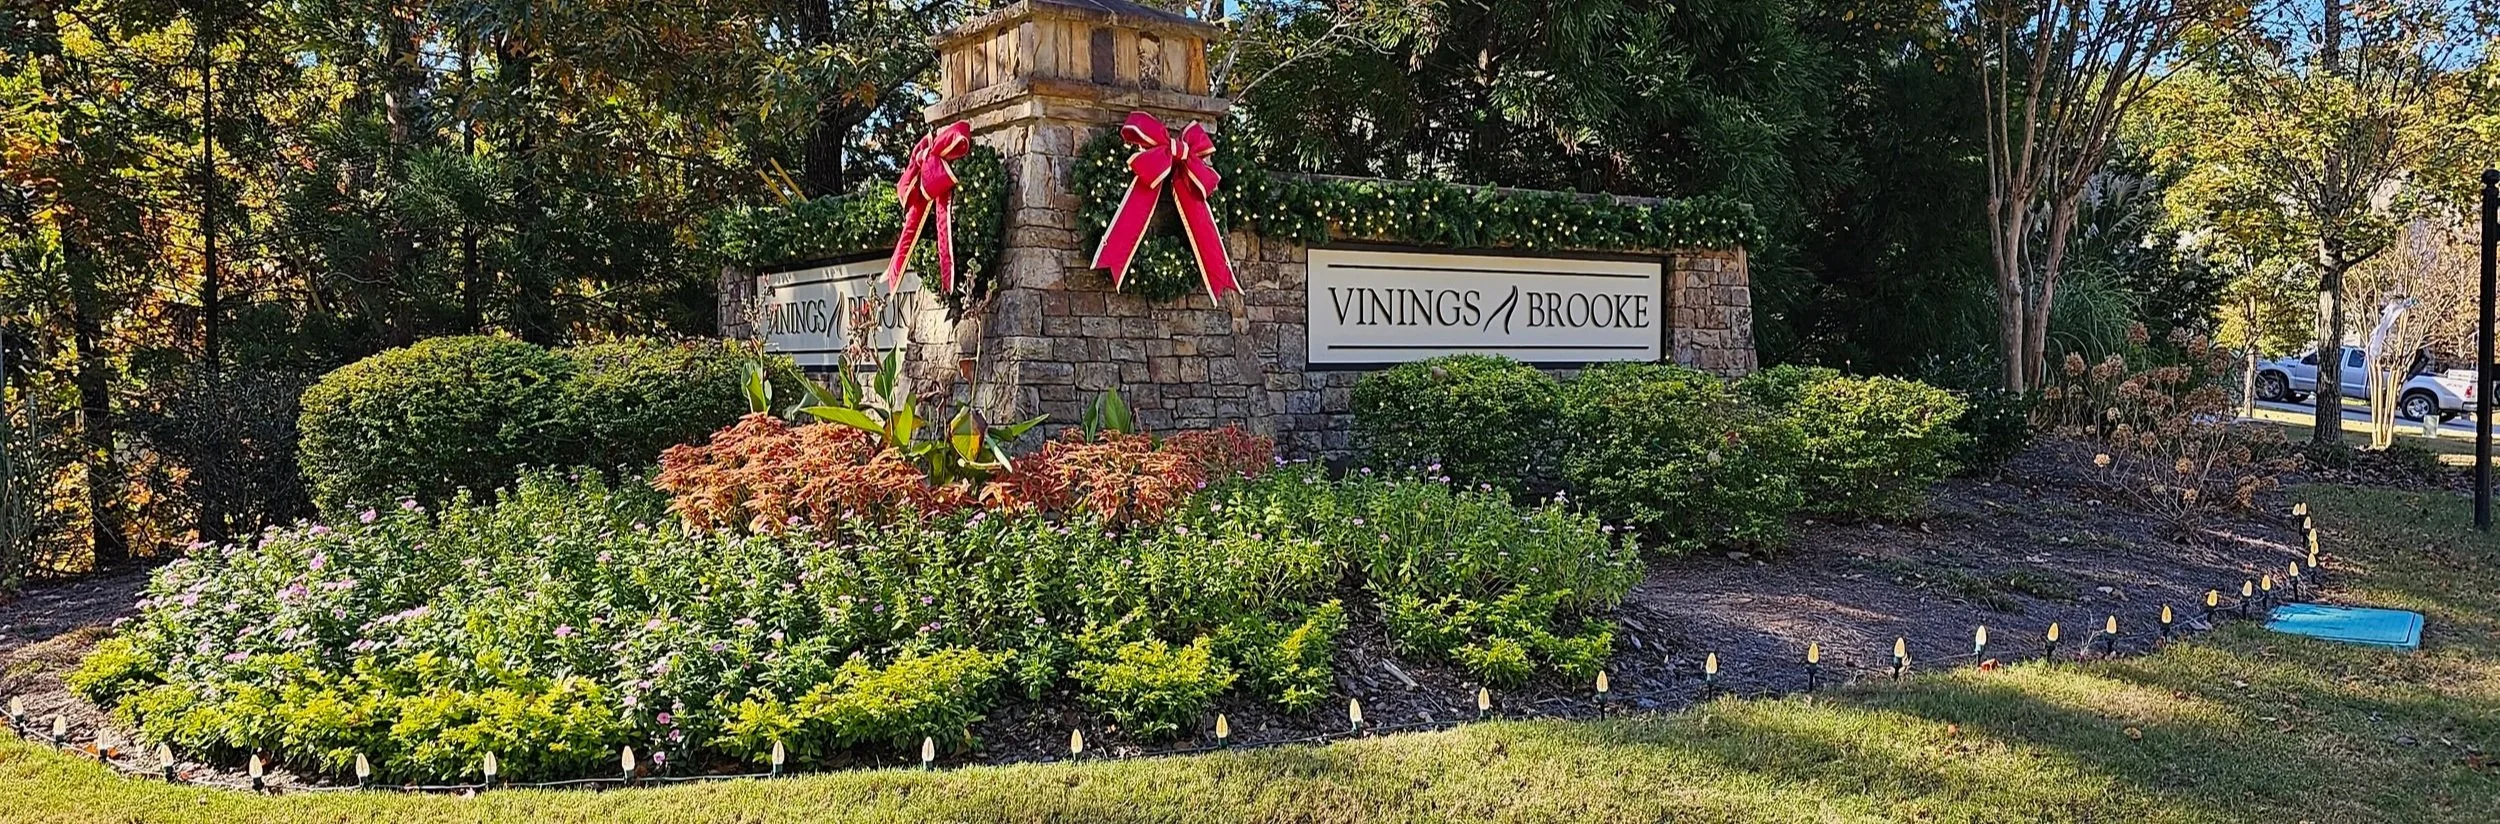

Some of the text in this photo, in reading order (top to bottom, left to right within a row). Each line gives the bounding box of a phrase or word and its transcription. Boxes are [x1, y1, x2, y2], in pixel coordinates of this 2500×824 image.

[848, 290, 917, 330] BROK
[1328, 286, 1651, 329] VININGS BROOKE
